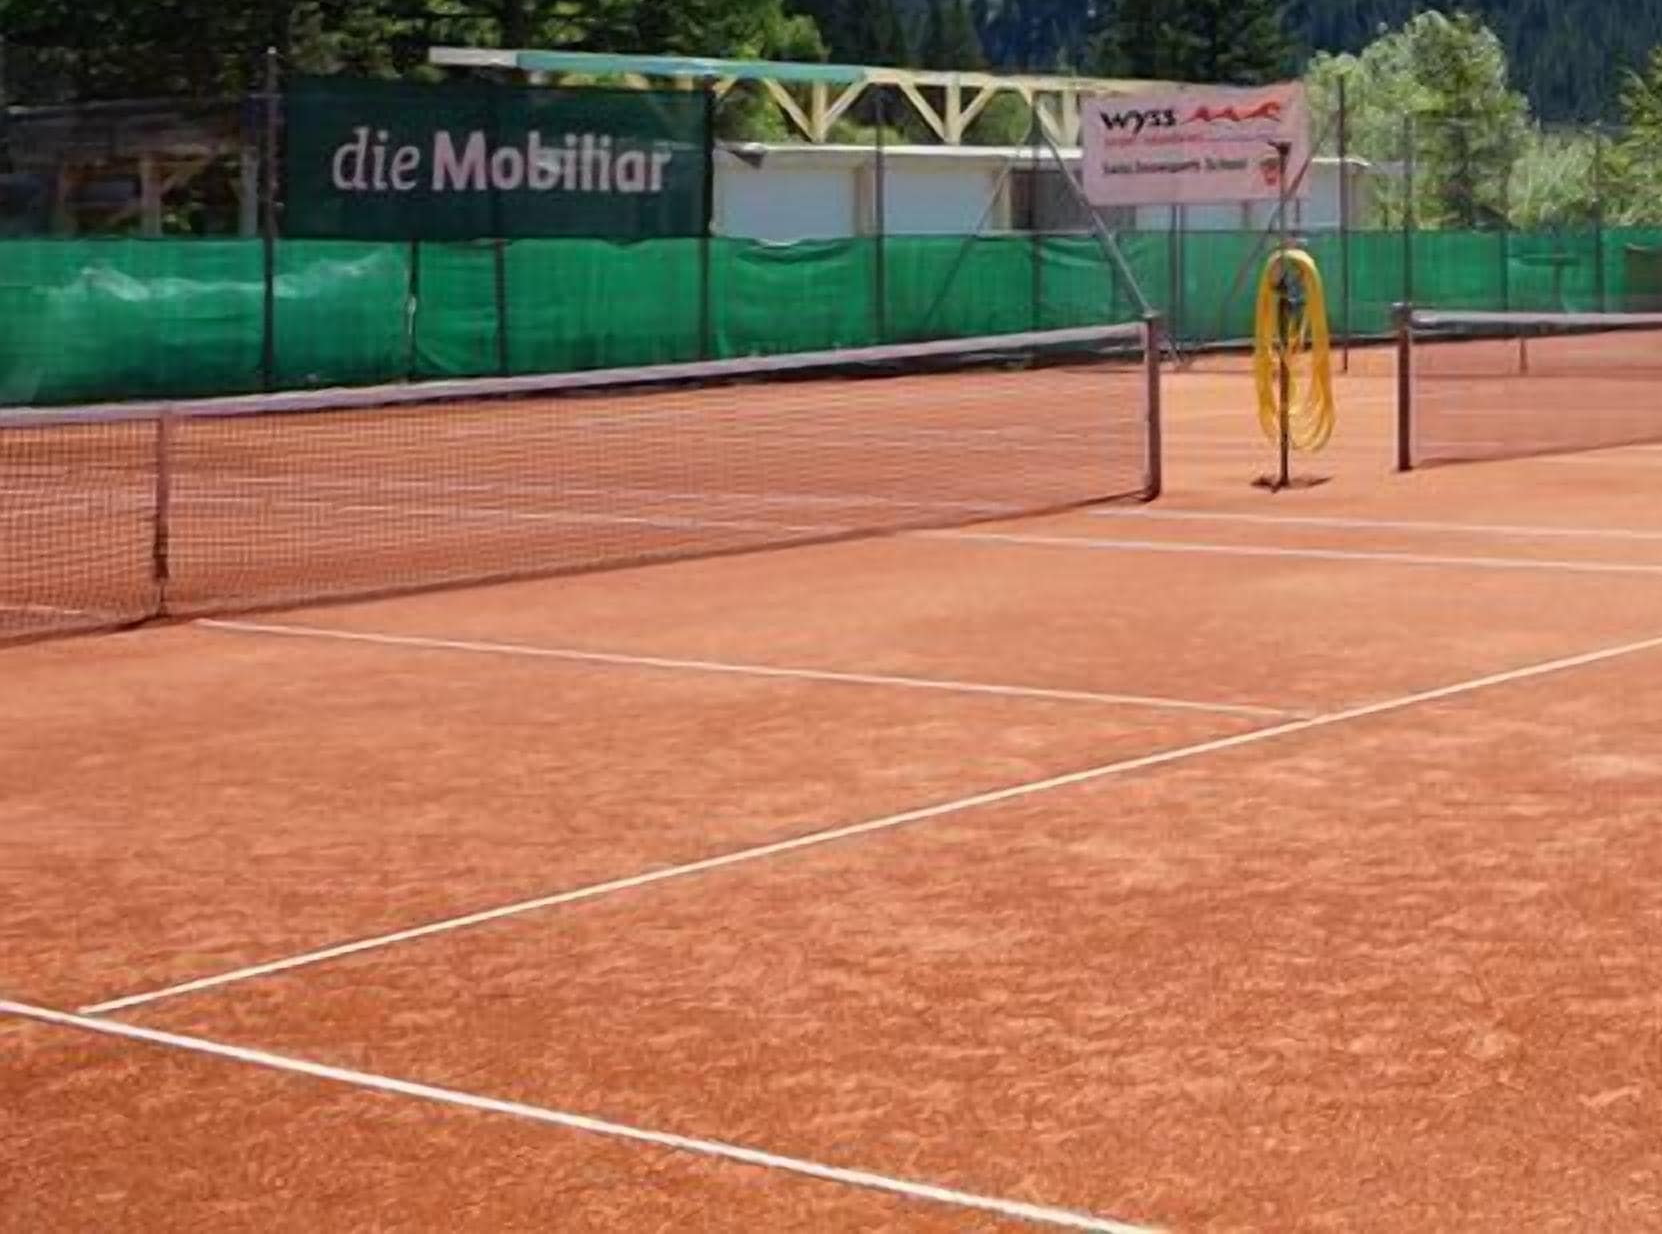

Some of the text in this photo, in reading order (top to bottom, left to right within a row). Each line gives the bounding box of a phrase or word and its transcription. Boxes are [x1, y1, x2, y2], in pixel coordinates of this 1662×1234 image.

[1100, 108, 1177, 135] wyss
[331, 126, 672, 193] die Mobiliar
